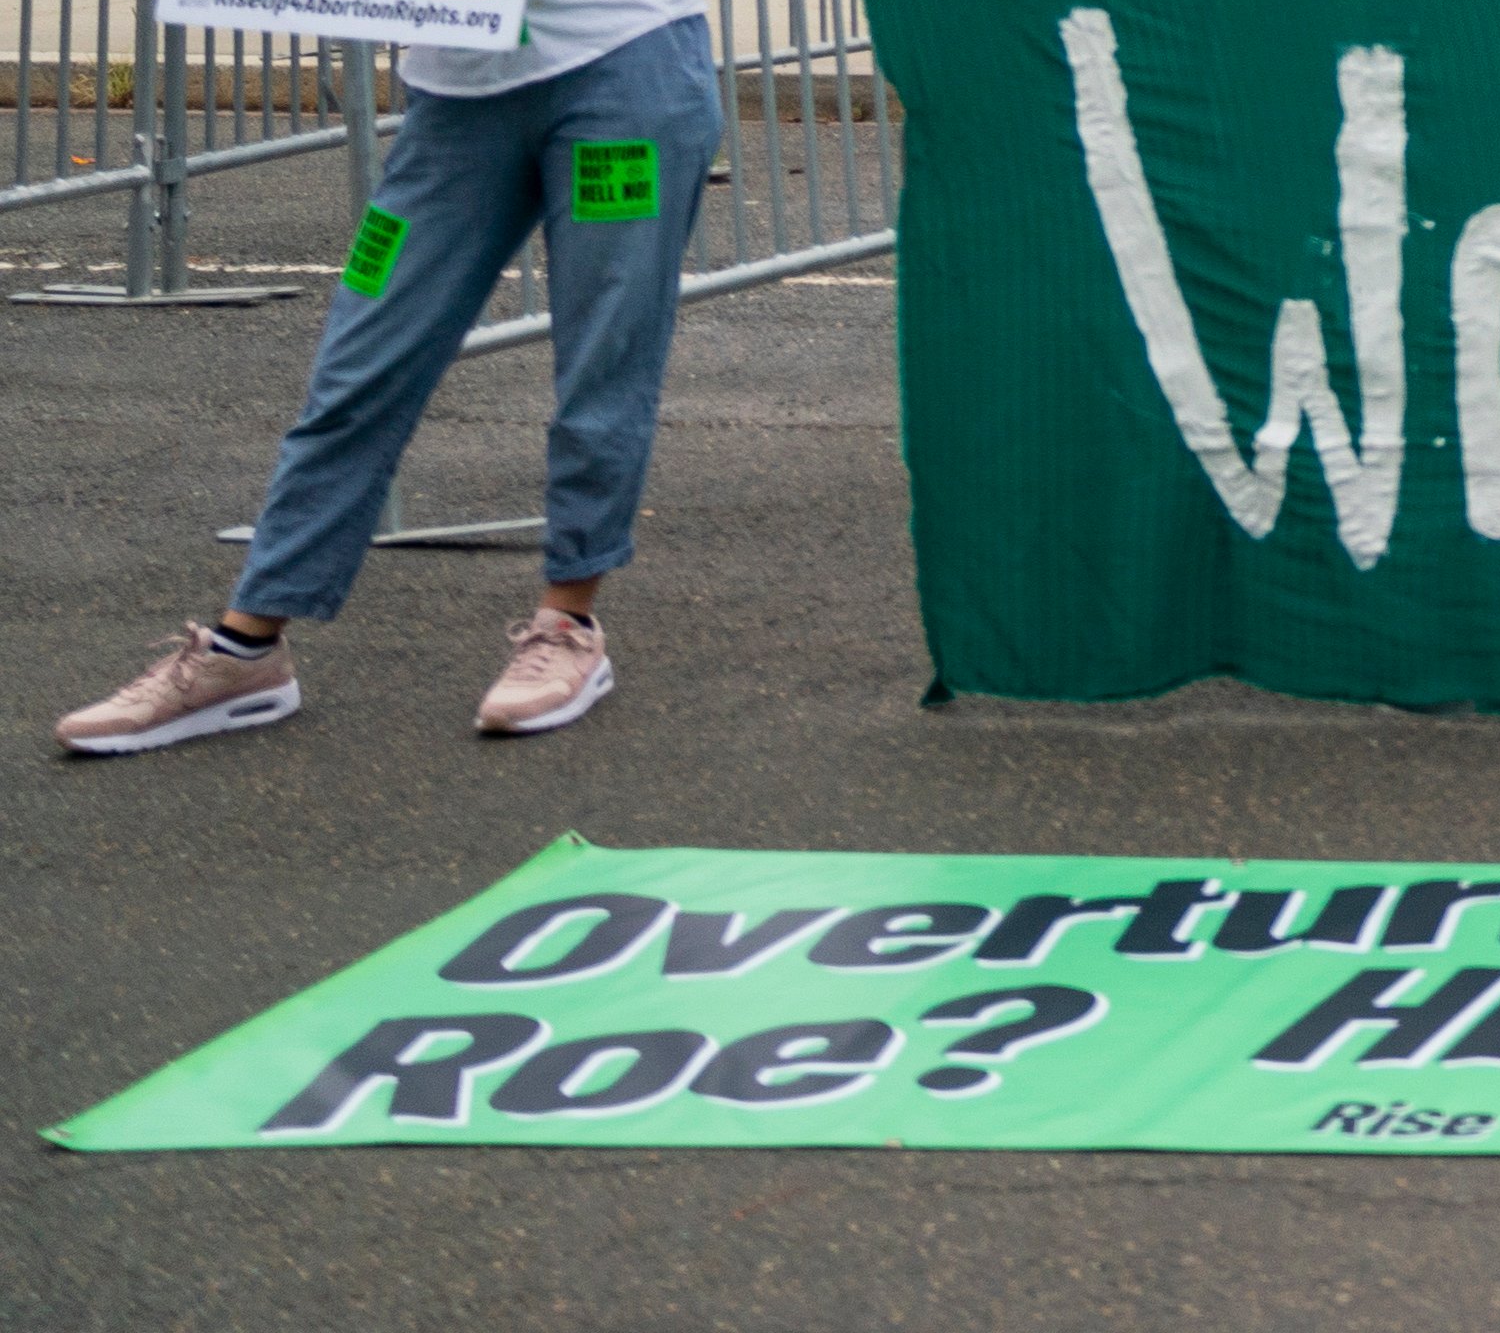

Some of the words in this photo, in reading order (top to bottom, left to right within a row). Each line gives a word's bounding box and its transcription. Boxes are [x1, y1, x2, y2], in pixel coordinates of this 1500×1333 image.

[579, 183, 615, 202] HELL
[258, 984, 1110, 1134] Roe?
[1309, 1100, 1496, 1143] Rise
